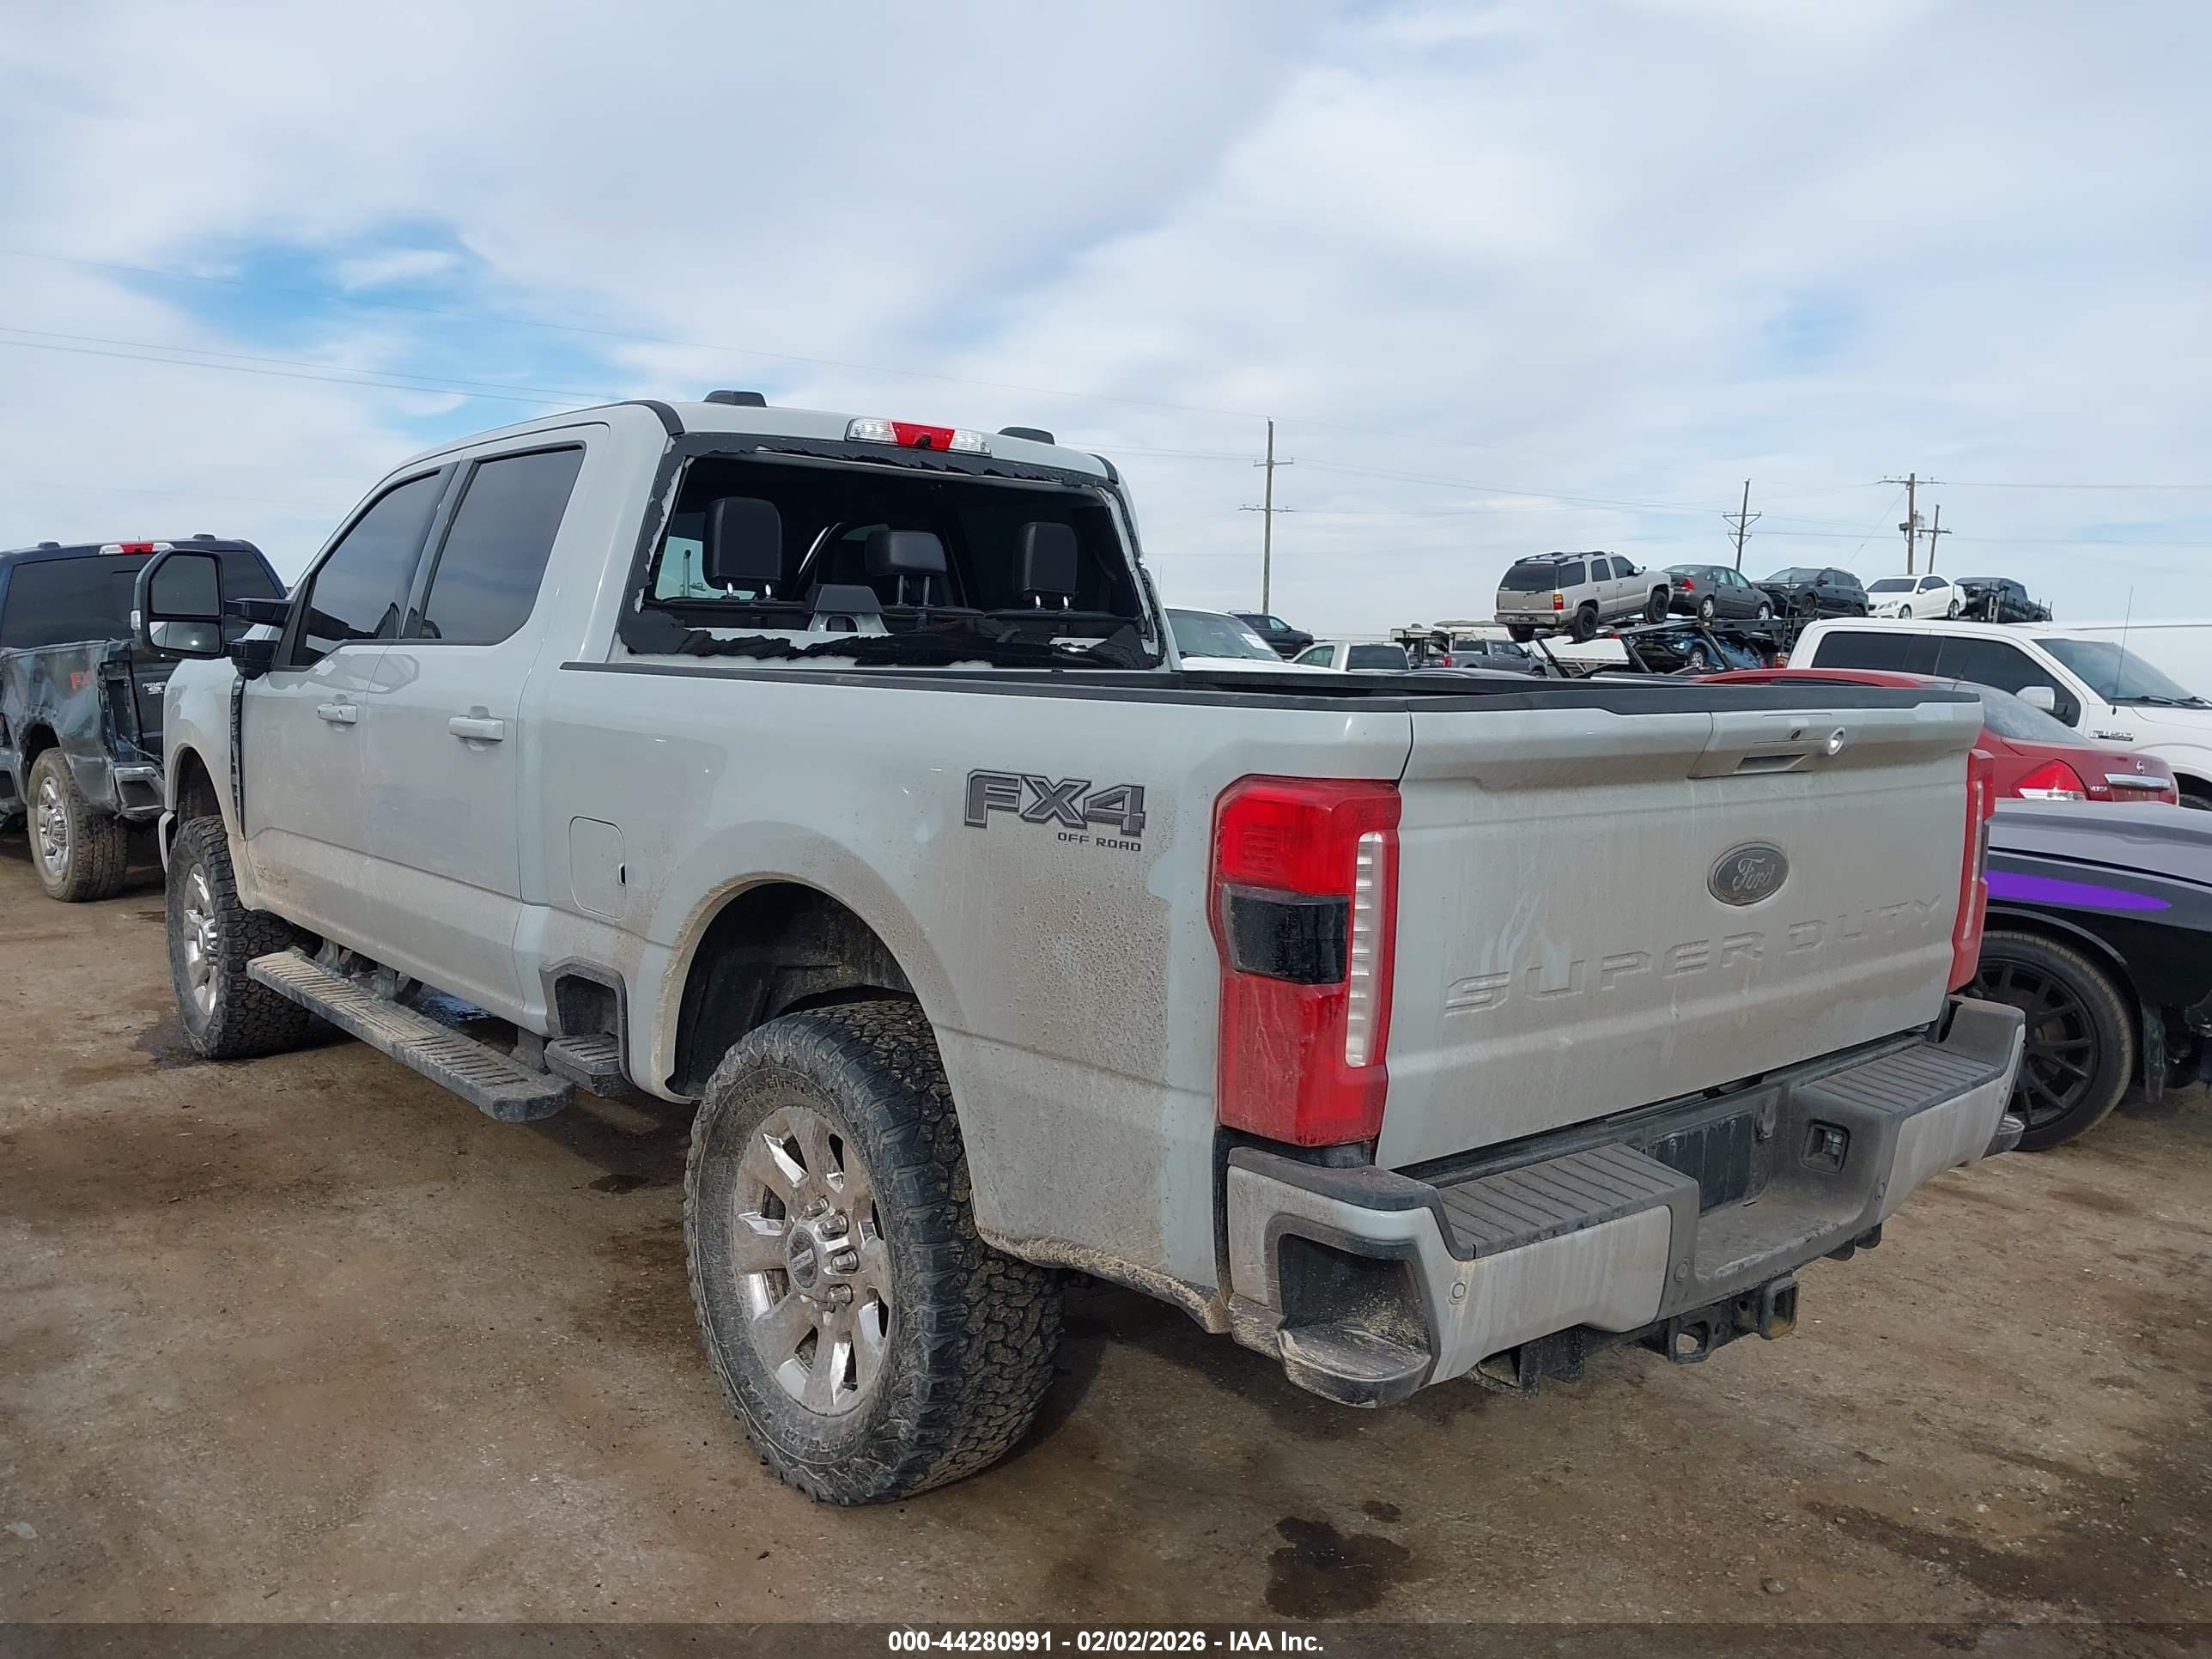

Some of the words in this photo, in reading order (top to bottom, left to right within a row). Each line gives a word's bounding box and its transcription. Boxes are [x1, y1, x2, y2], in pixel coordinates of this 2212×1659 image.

[964, 769, 1146, 838] FX4
[1057, 831, 1090, 845] OFF
[1096, 836, 1142, 852] ROAD
[1732, 857, 1776, 892] Ford
[1444, 930, 1765, 1017] SUPER
[1786, 895, 1941, 955] DUTY
